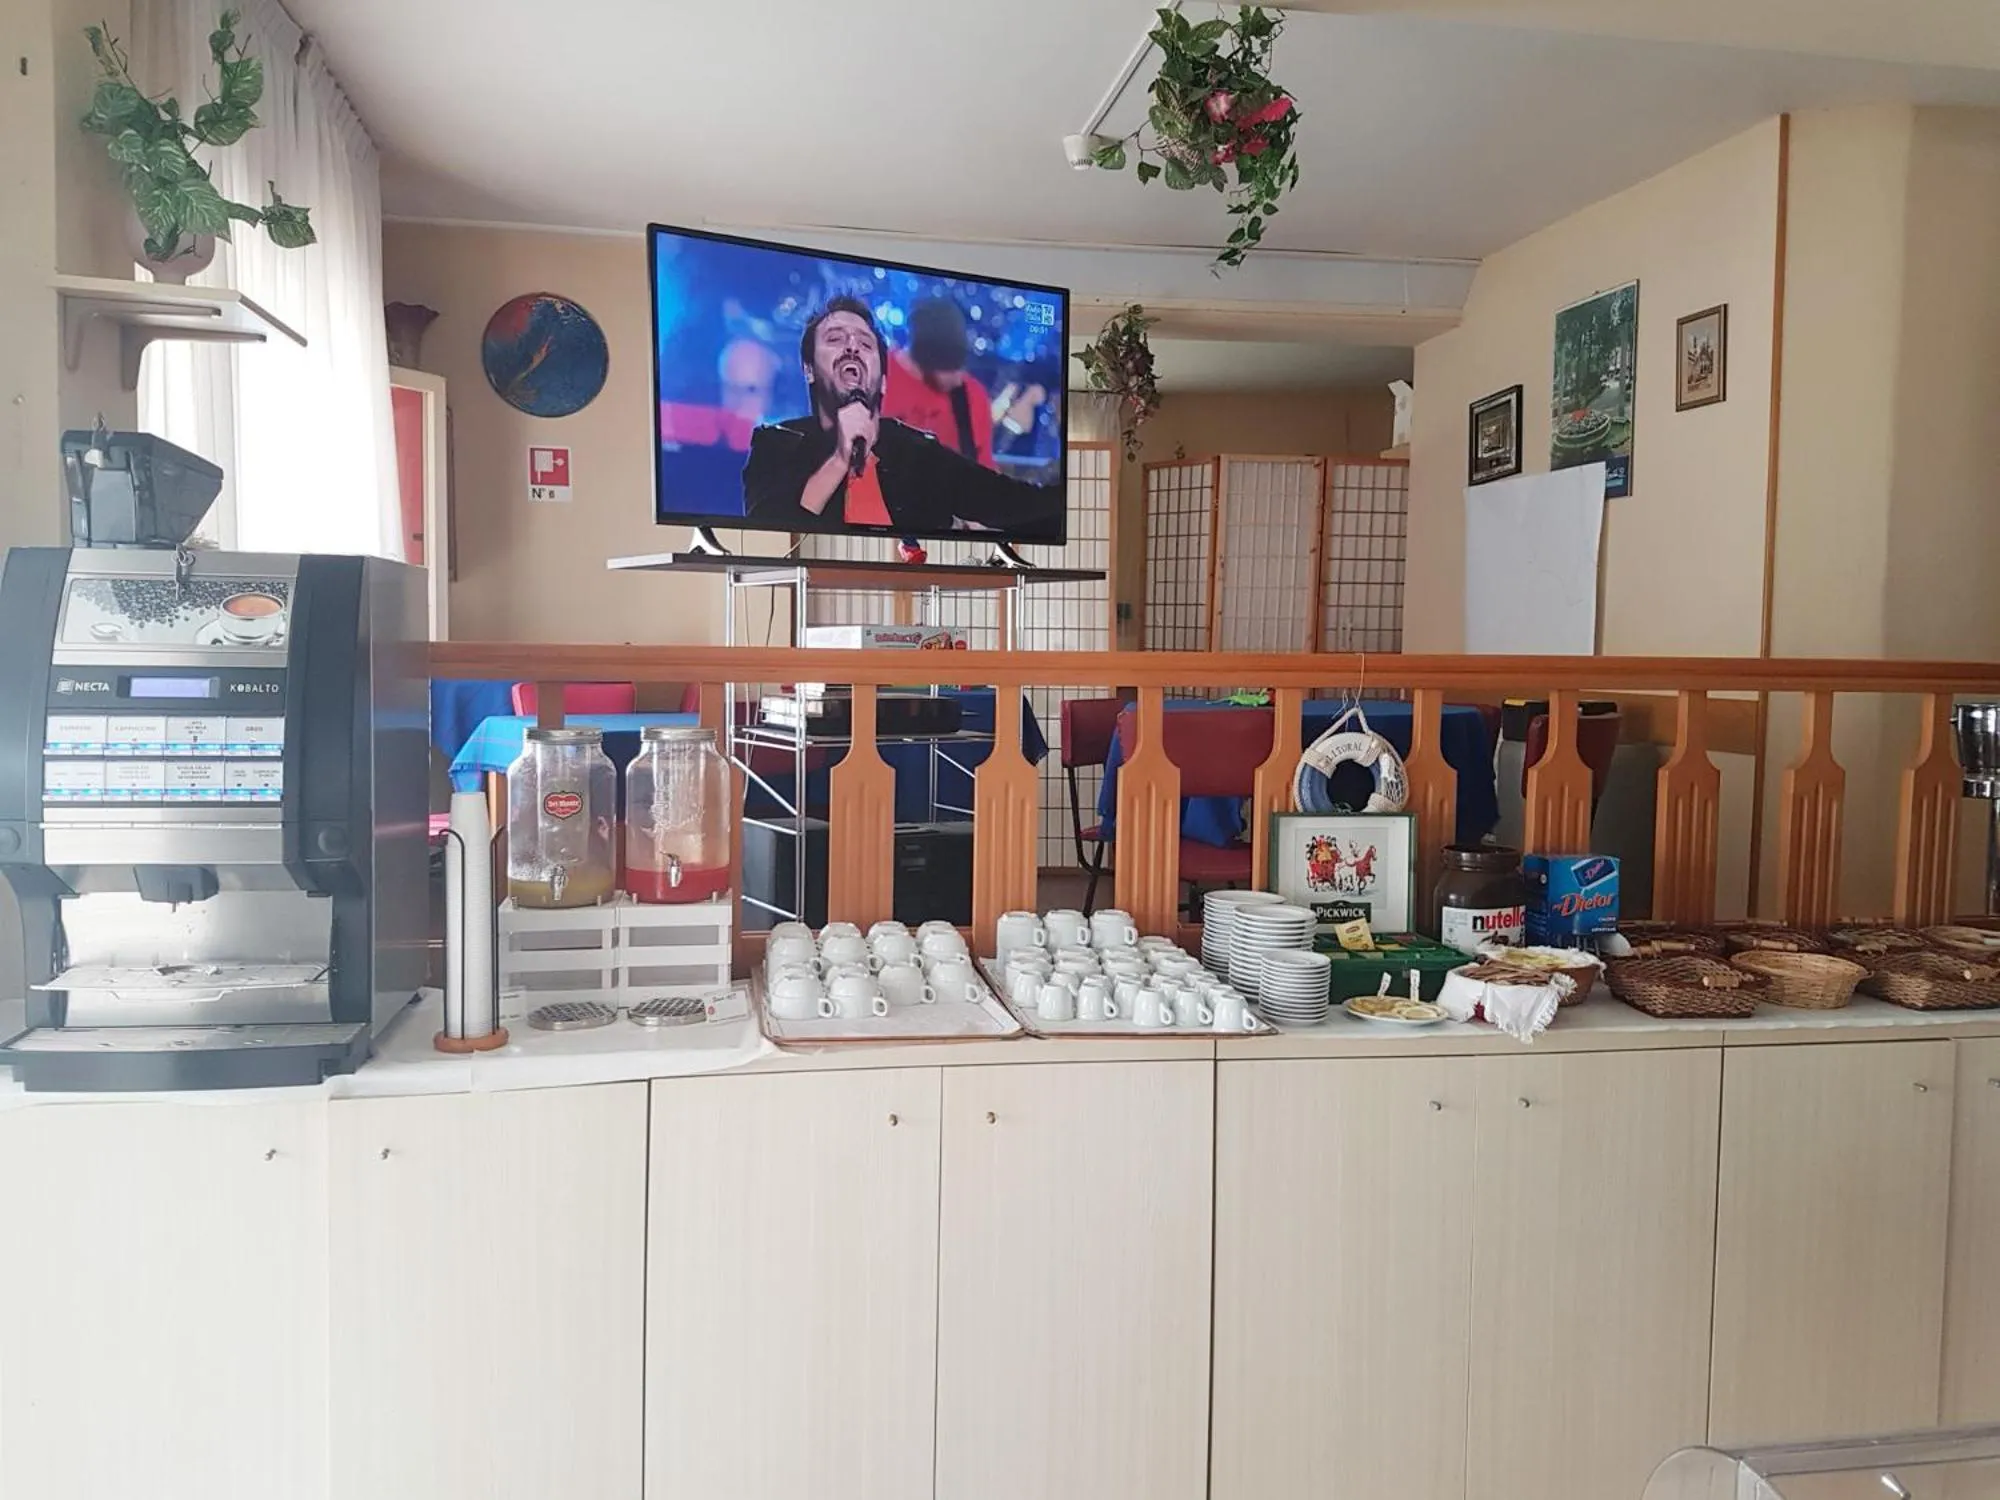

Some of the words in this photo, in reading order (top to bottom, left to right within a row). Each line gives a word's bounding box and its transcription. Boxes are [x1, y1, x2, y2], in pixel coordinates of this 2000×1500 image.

[75, 681, 110, 691] NECTA
[230, 683, 279, 693] KOBALTO
[1316, 906, 1366, 918] PICKWICK
